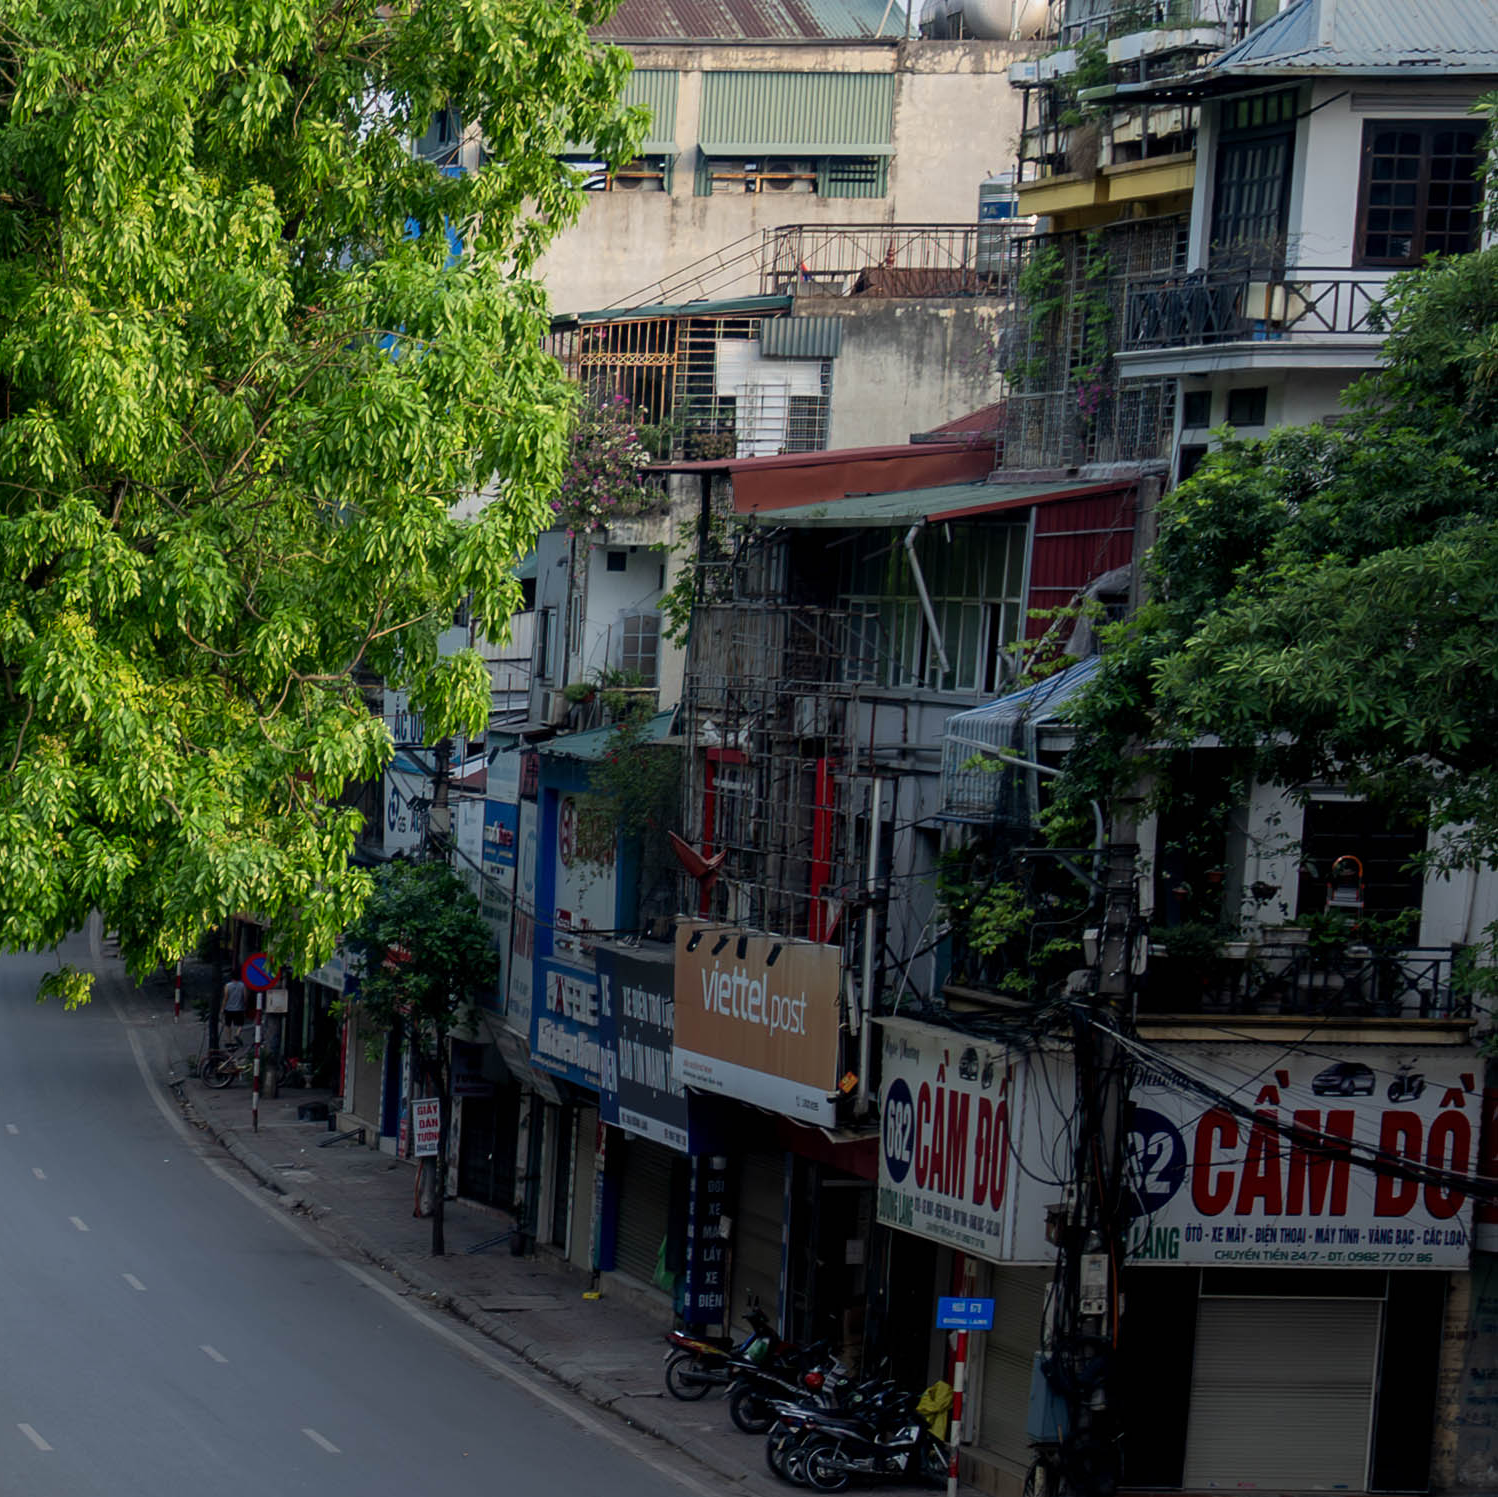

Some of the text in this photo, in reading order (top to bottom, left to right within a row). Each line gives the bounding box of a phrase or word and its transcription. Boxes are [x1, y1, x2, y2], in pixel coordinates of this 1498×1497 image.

[701, 959, 808, 1038] viettel post
[886, 1098, 913, 1164] 682
[915, 1049, 970, 1200] CẦM
[1191, 1069, 1355, 1217] CẦM
[1373, 1073, 1475, 1220] ĐỒ
[1123, 1131, 1175, 1195] 82
[1211, 1226, 1224, 1243] XE
[1226, 1223, 1247, 1243] MÁY
[1255, 1224, 1277, 1247] ĐIỆN
[1280, 1226, 1306, 1247] THOẠI
[1315, 1224, 1335, 1244] MÁY
[1339, 1224, 1360, 1244] TÍNH
[1368, 1225, 1393, 1245] VÀNG
[1396, 1228, 1414, 1249] BẠC
[1423, 1226, 1442, 1246] CÁC
[705, 1271, 719, 1284] XE
